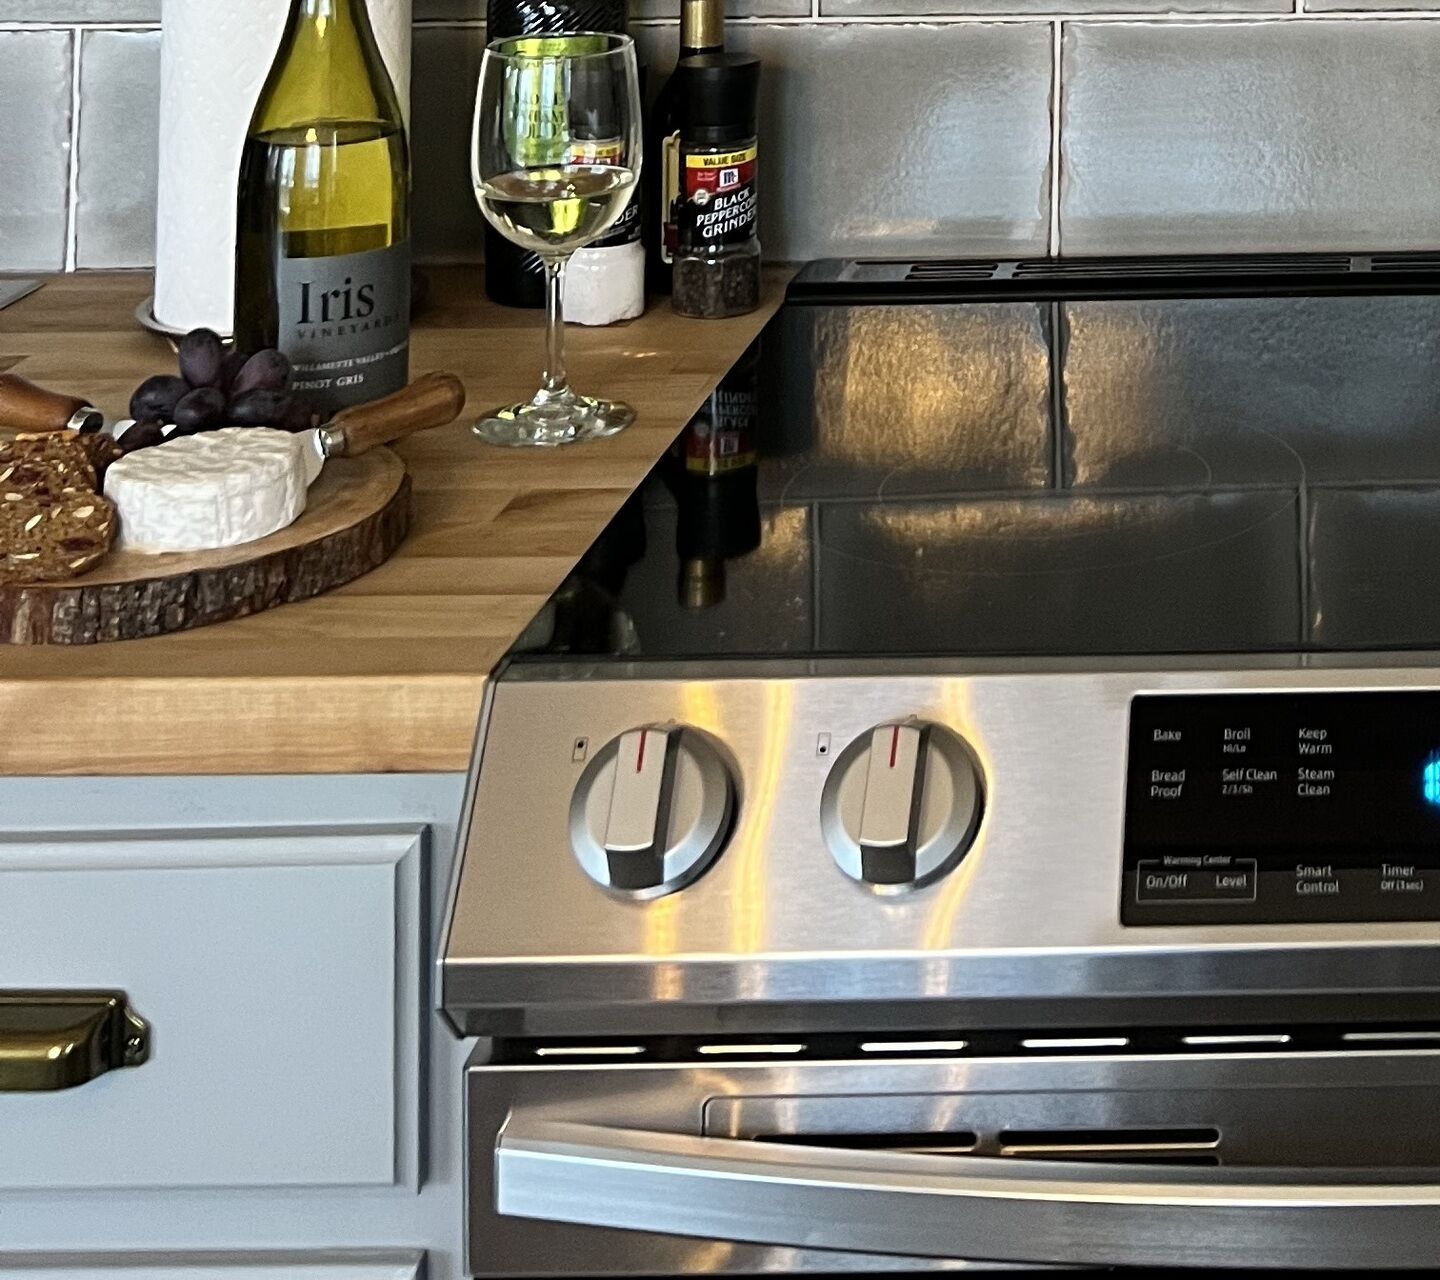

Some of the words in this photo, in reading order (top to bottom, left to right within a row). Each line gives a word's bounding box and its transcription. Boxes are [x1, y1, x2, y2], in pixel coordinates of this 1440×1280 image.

[714, 187, 750, 211] BLACK
[696, 192, 757, 227] PEPPERCO
[297, 277, 375, 324] Iris
[335, 373, 365, 388] GRIS
[1153, 728, 1182, 741] Bake
[1223, 727, 1251, 740] Broil
[1298, 728, 1328, 741] Keep
[1298, 742, 1333, 755] Warm
[1151, 768, 1186, 782] Bread
[1222, 768, 1245, 781] Self
[1246, 768, 1278, 781] Clean
[1297, 767, 1335, 780] Steam
[1150, 783, 1183, 798] Proof
[1297, 783, 1331, 796] Clean
[1296, 864, 1333, 877] Smart
[1381, 864, 1415, 877] Timer
[1146, 874, 1188, 890] On/Off
[1216, 874, 1248, 888] Level
[1296, 881, 1340, 894] Control
